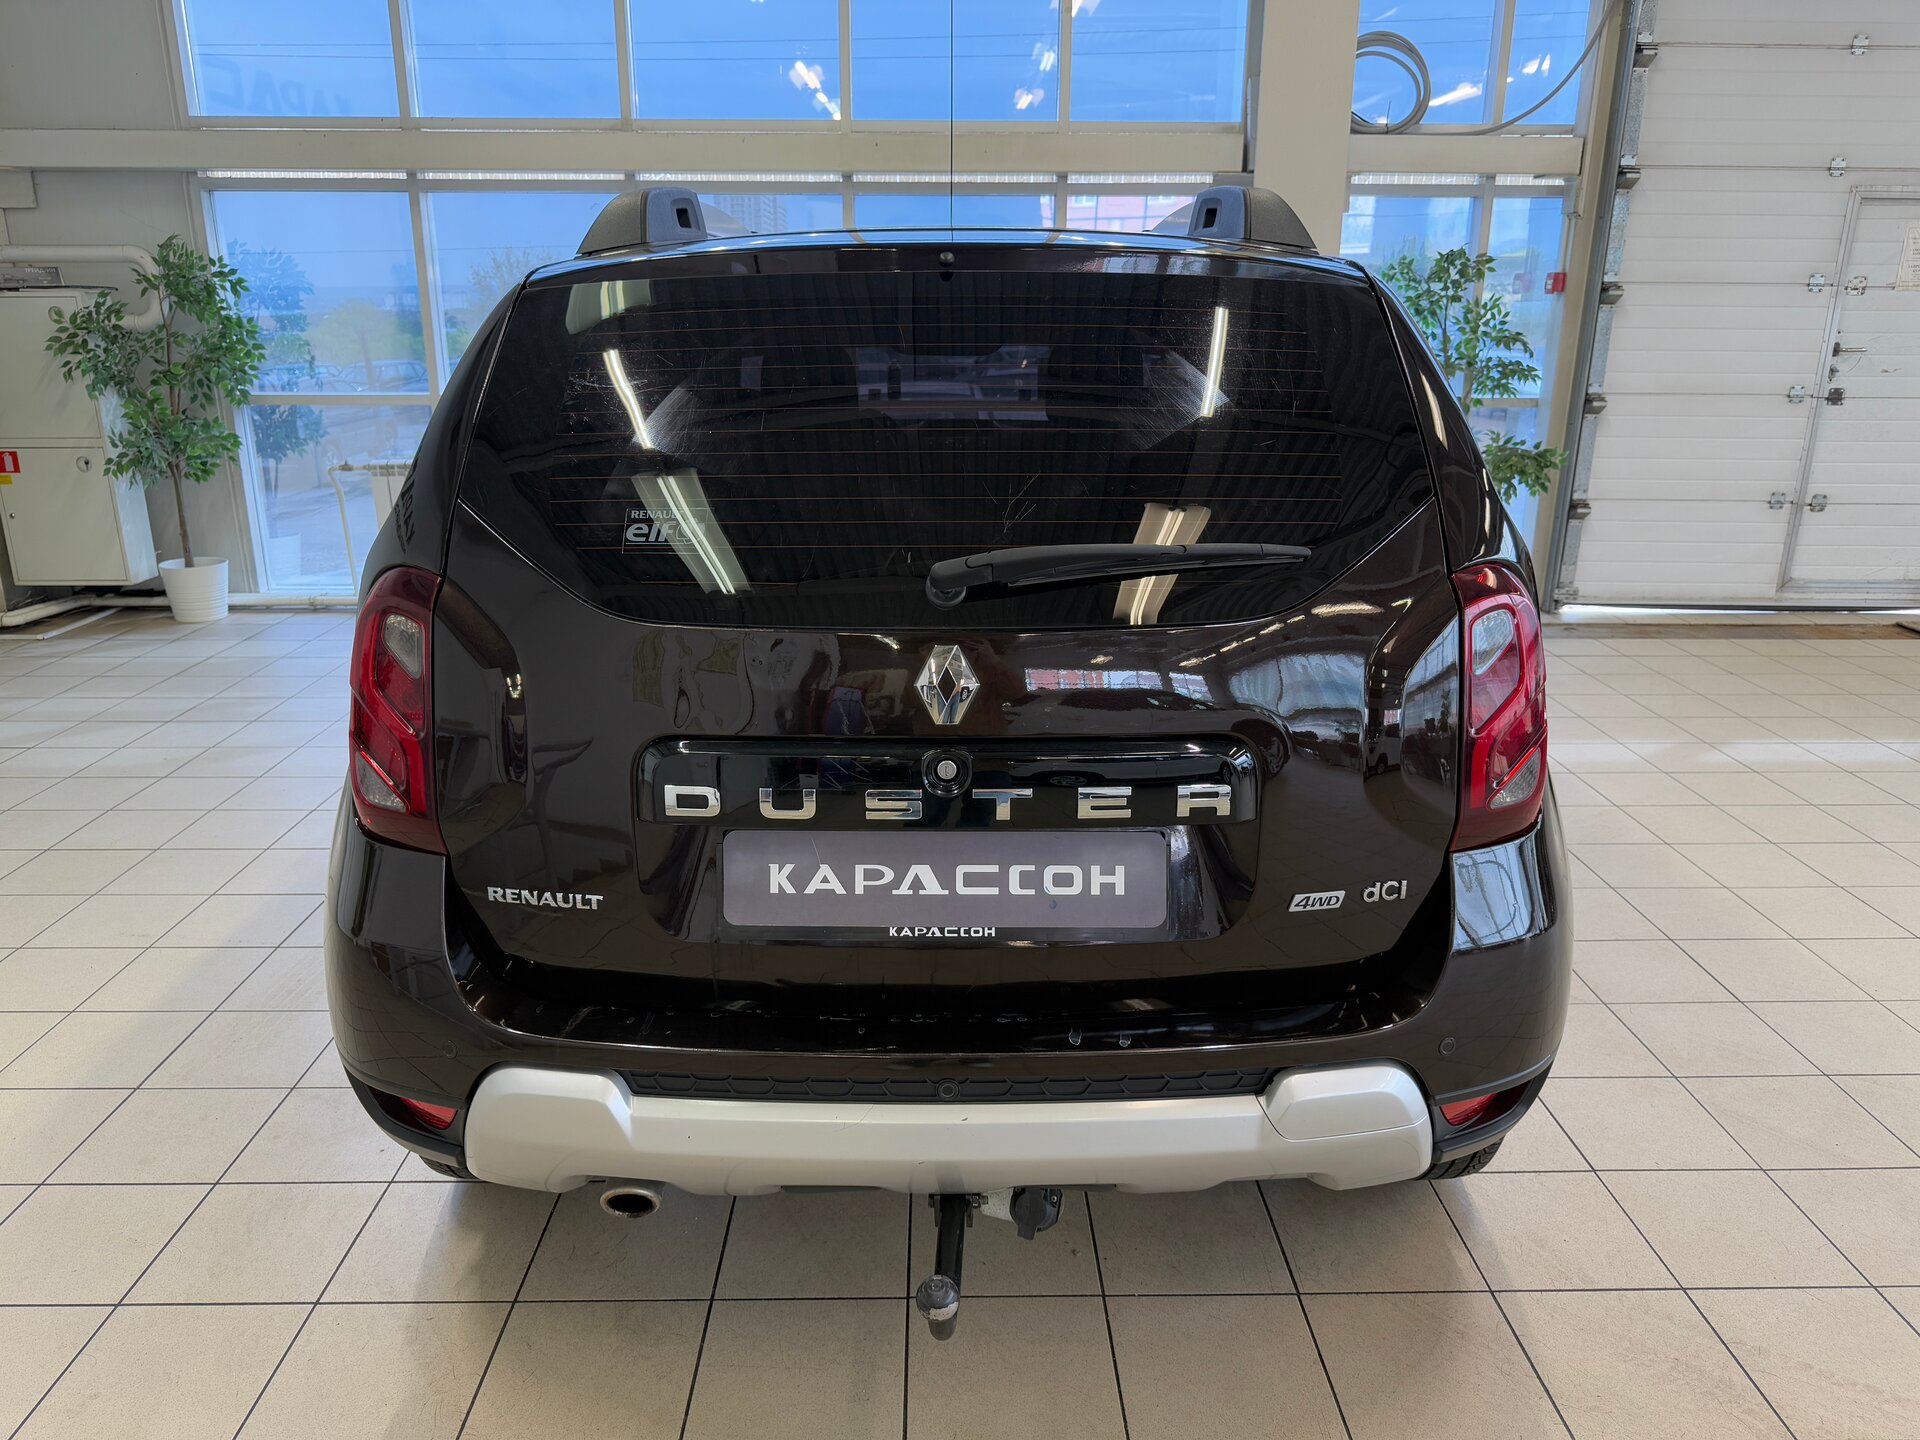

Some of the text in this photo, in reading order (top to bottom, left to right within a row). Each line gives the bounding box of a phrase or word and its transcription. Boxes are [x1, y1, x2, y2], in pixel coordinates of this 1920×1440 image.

[631, 510, 684, 519] RENAUL
[625, 521, 677, 543] elf
[664, 784, 1232, 821] DUSTER
[768, 863, 1126, 897] КАРАССОН
[487, 886, 604, 910] RENAULT
[1293, 894, 1341, 910] 4WD
[889, 926, 997, 937] КАРАССОН
